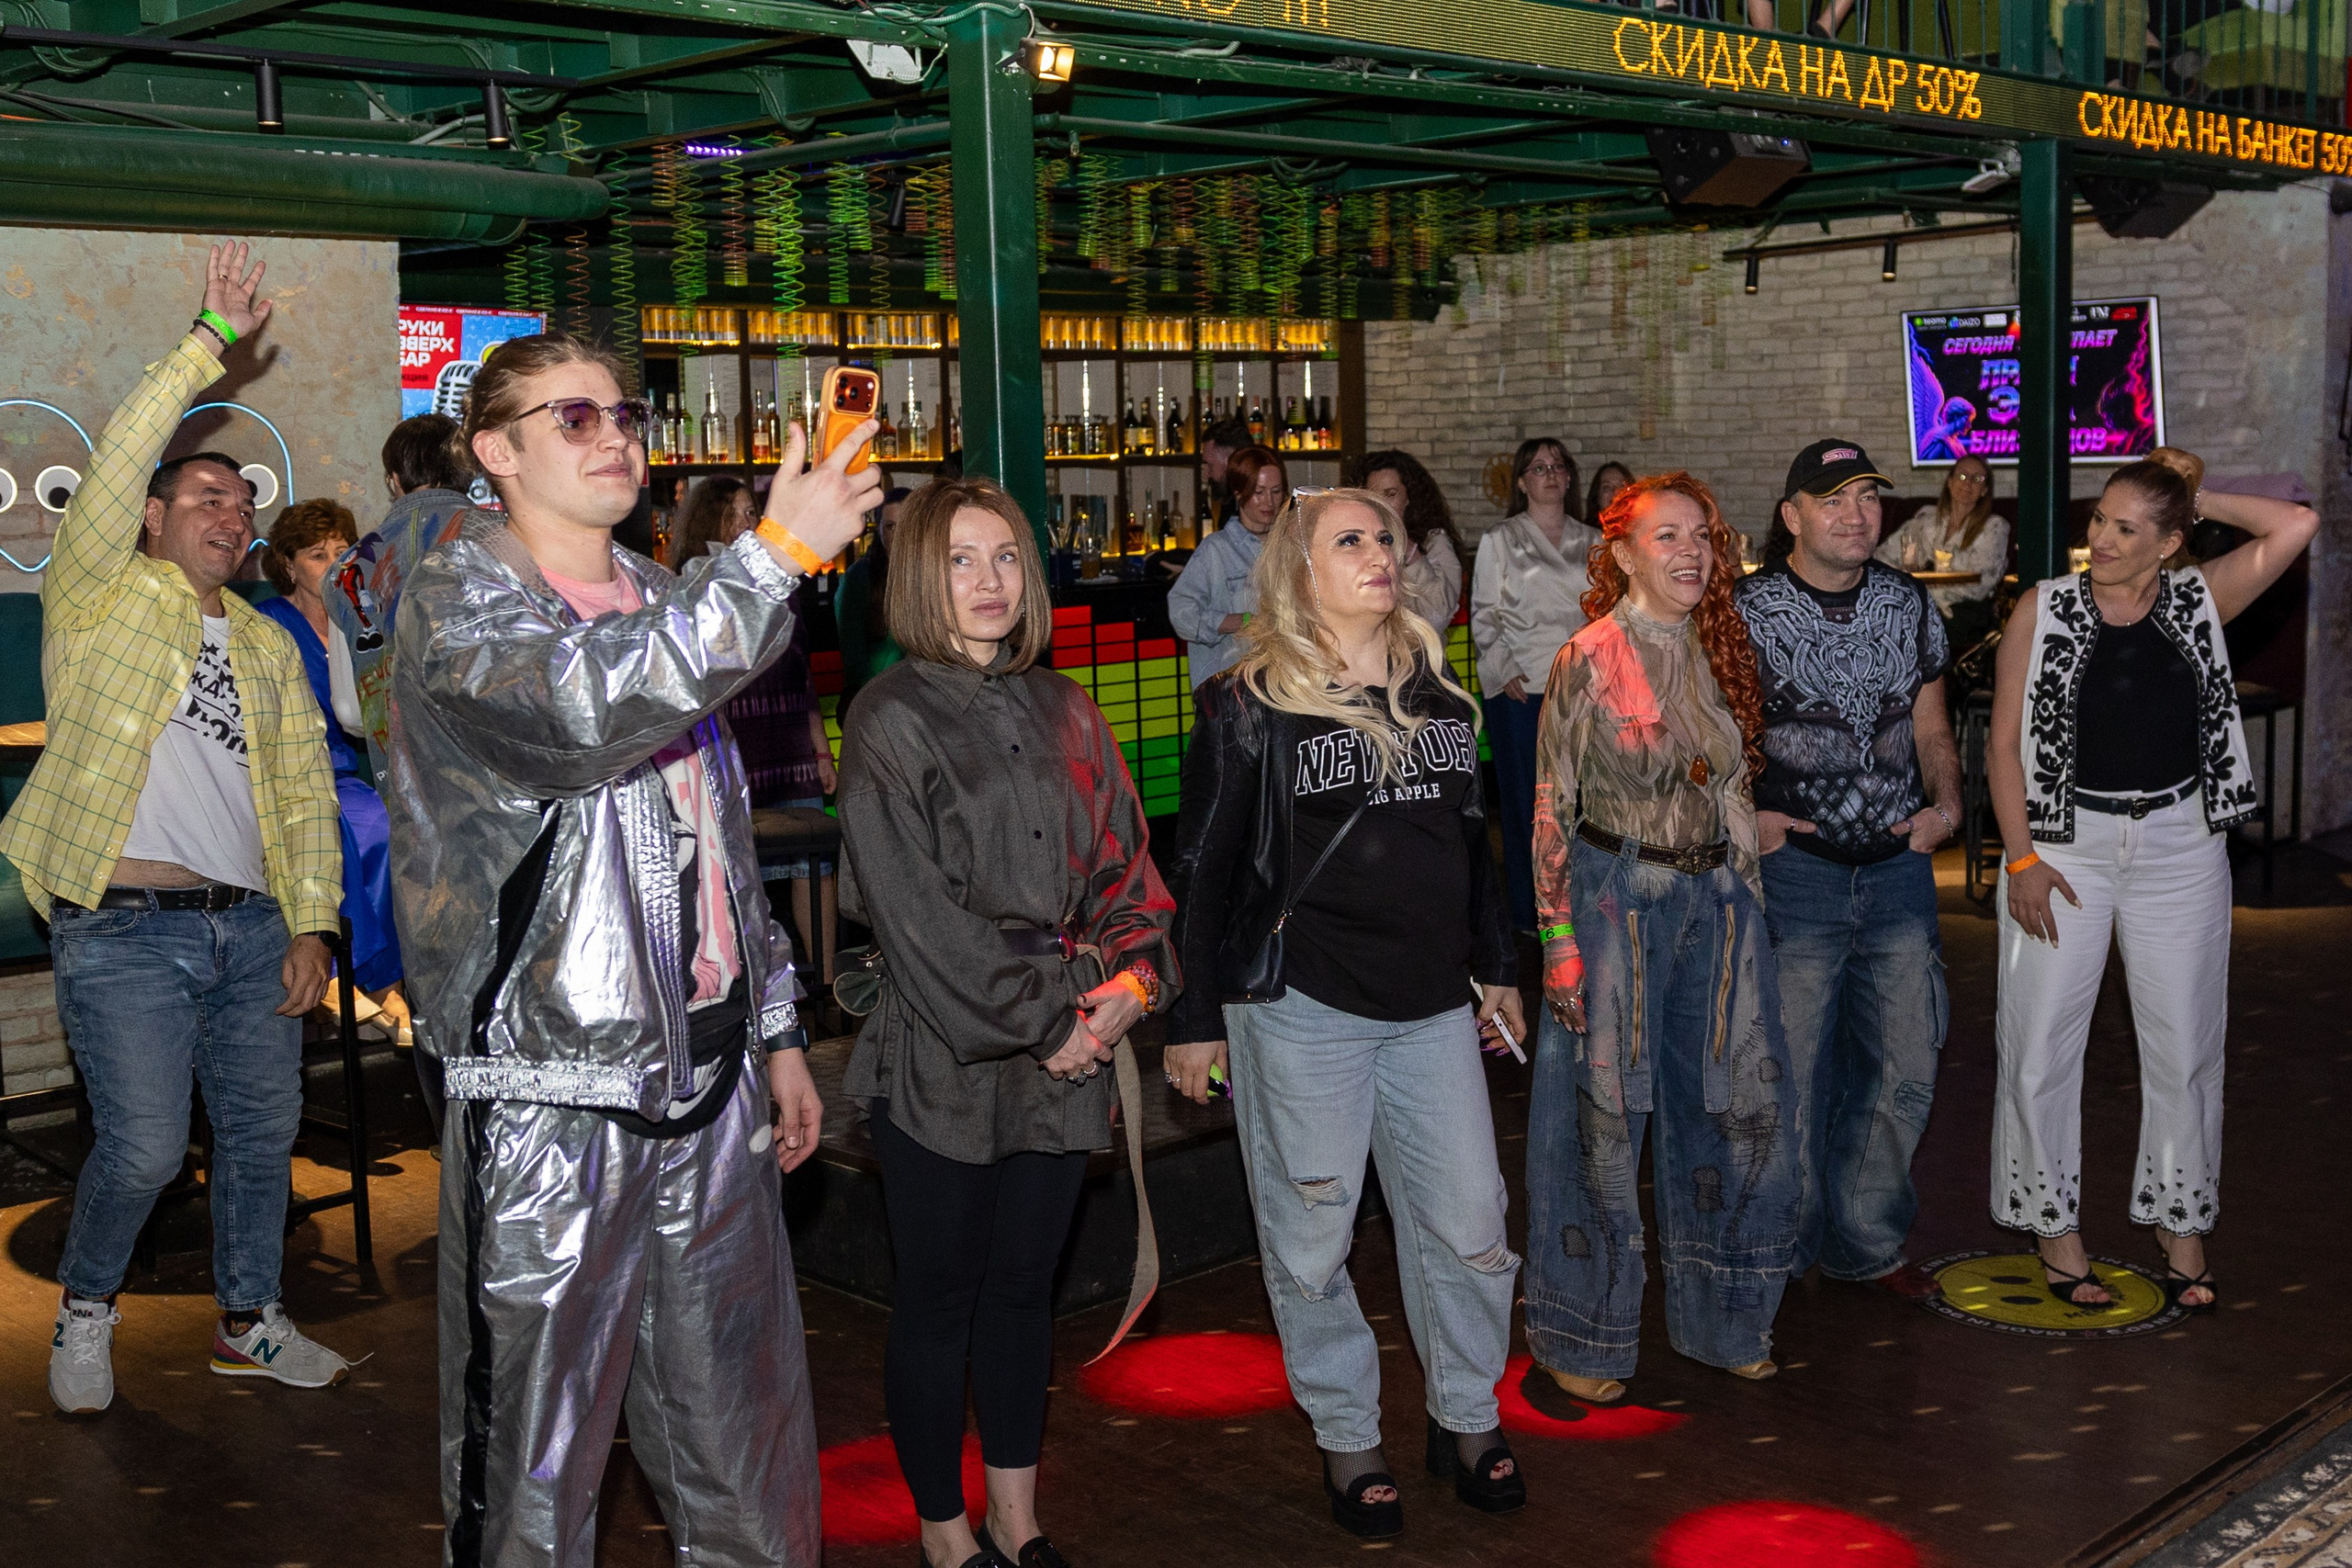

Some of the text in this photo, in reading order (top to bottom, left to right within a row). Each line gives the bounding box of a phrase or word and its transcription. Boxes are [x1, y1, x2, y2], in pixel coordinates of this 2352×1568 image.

[1612, 17, 1982, 119] СКИДКА НА ДР 50%
[2077, 91, 2192, 152] СКИДКА
[2196, 110, 2233, 157] НА
[1942, 335, 2016, 355] СЕГОДНЯ
[1395, 783, 1441, 801] APPLE
[249, 1336, 285, 1366] N
